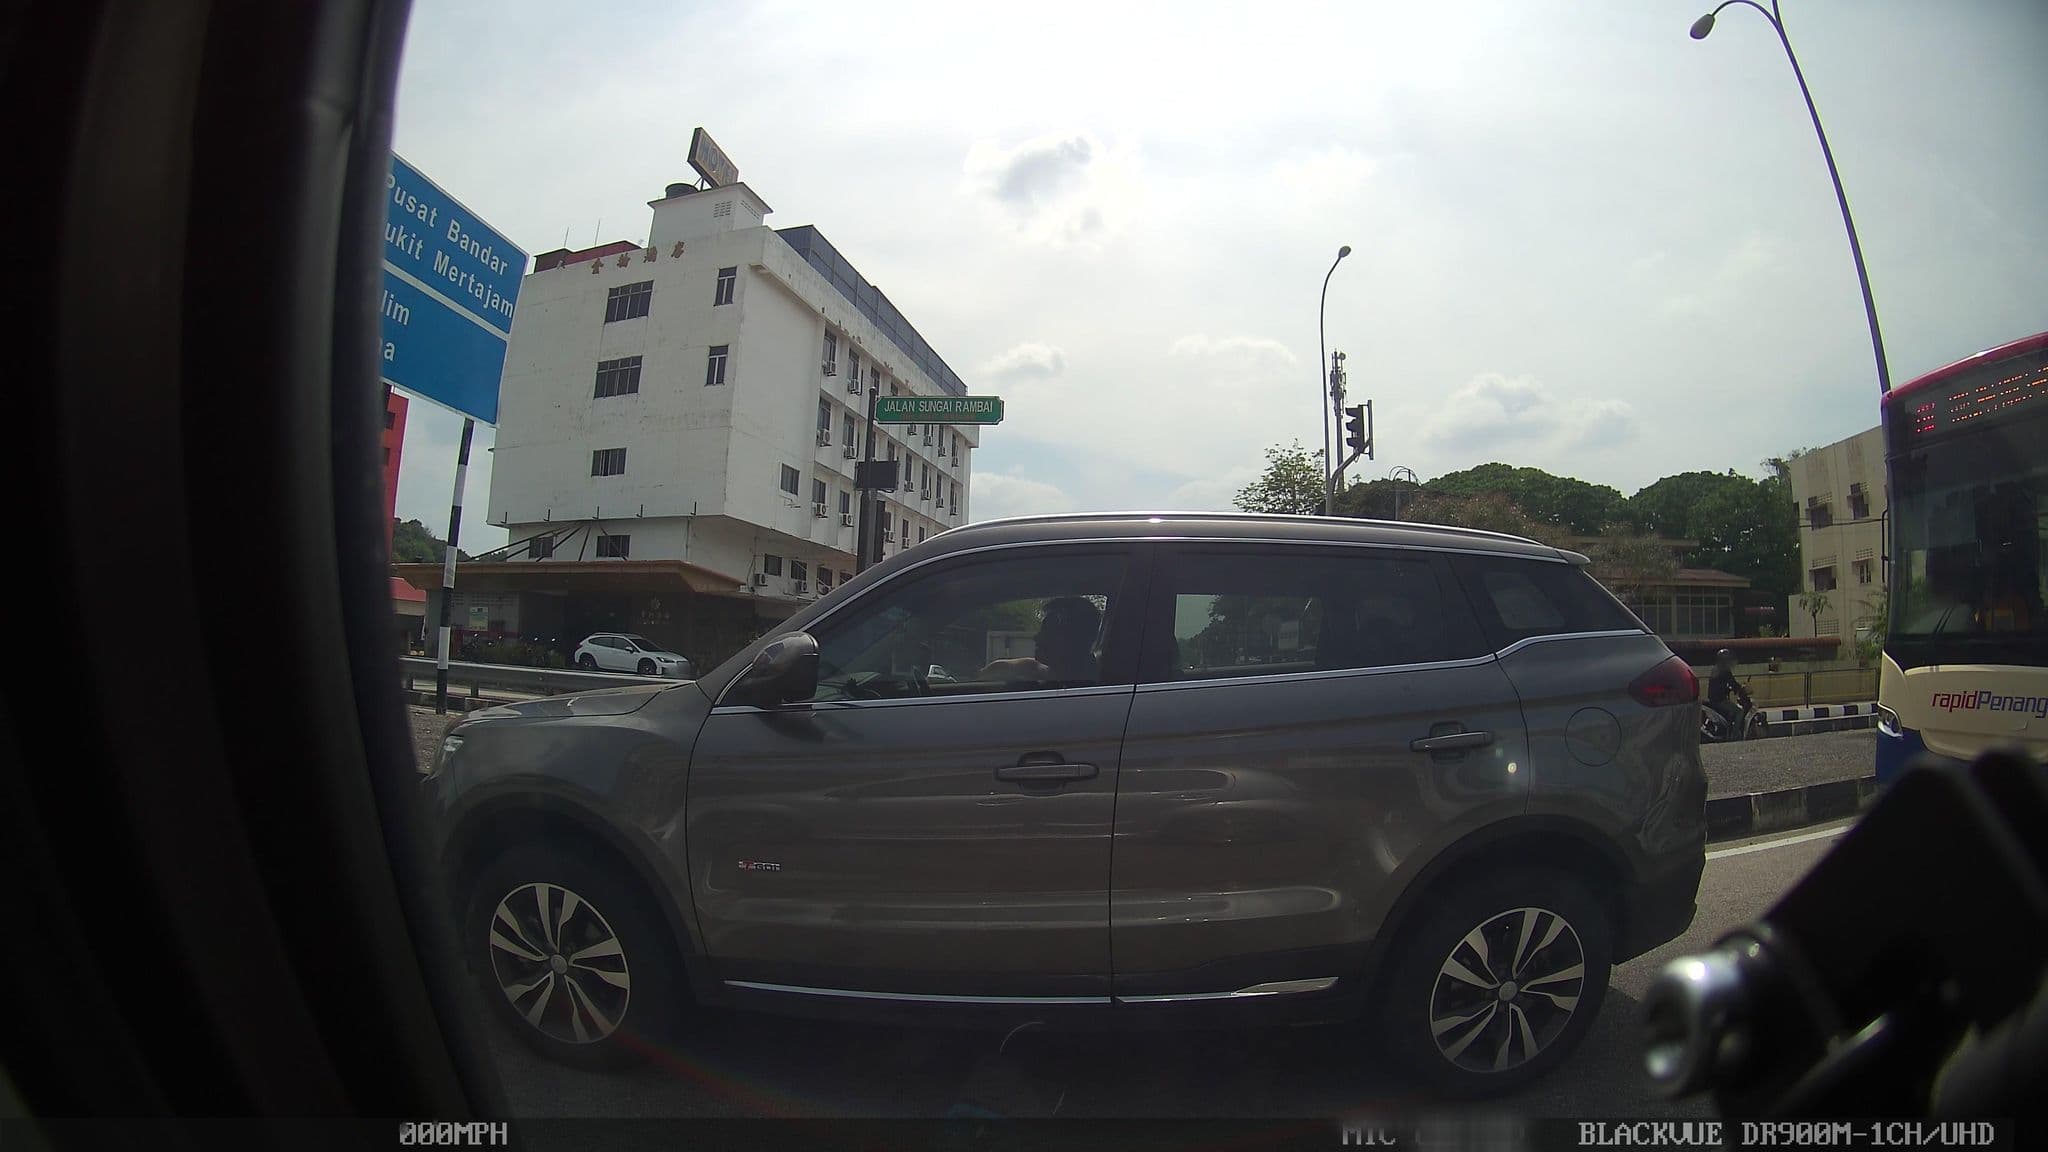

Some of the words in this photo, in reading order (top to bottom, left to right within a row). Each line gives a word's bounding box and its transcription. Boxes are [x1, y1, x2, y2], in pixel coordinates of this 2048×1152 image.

[447, 219, 508, 276] Bandar
[384, 222, 424, 260] ukit
[433, 250, 514, 318] Mertajam
[380, 289, 410, 325] lim
[884, 400, 915, 413] JALAN
[918, 400, 952, 413] SUNGAI
[955, 400, 993, 413] RAMBAI
[1932, 690, 2048, 719] rapidPenang
